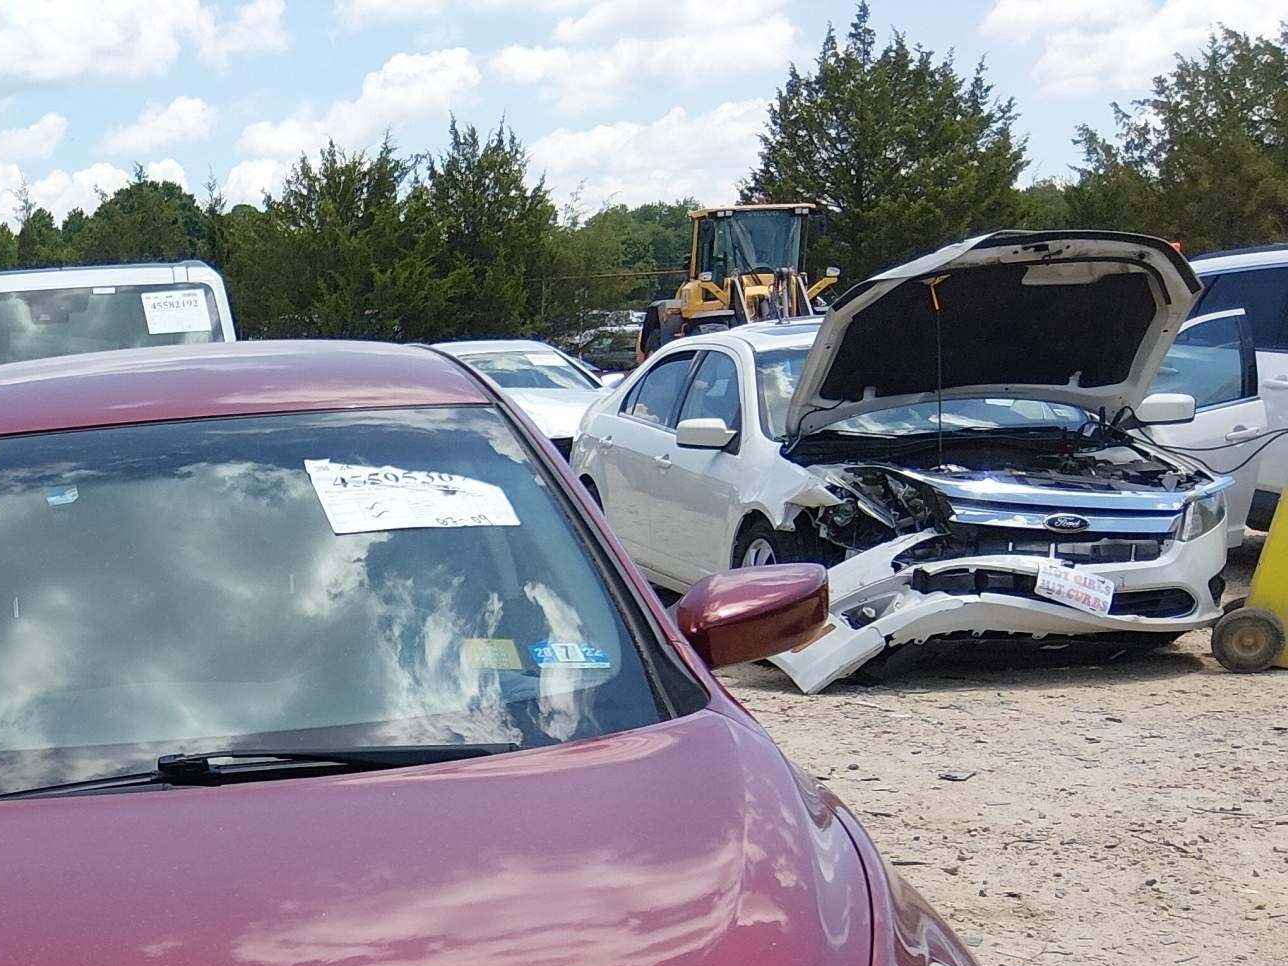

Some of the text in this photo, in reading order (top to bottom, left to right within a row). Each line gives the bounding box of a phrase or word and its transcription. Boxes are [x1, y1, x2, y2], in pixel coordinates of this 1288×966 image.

[1054, 517, 1081, 528] Ford
[1073, 574, 1112, 596] GIRLS
[1066, 588, 1110, 612] CURBS
[559, 645, 571, 660] 7
